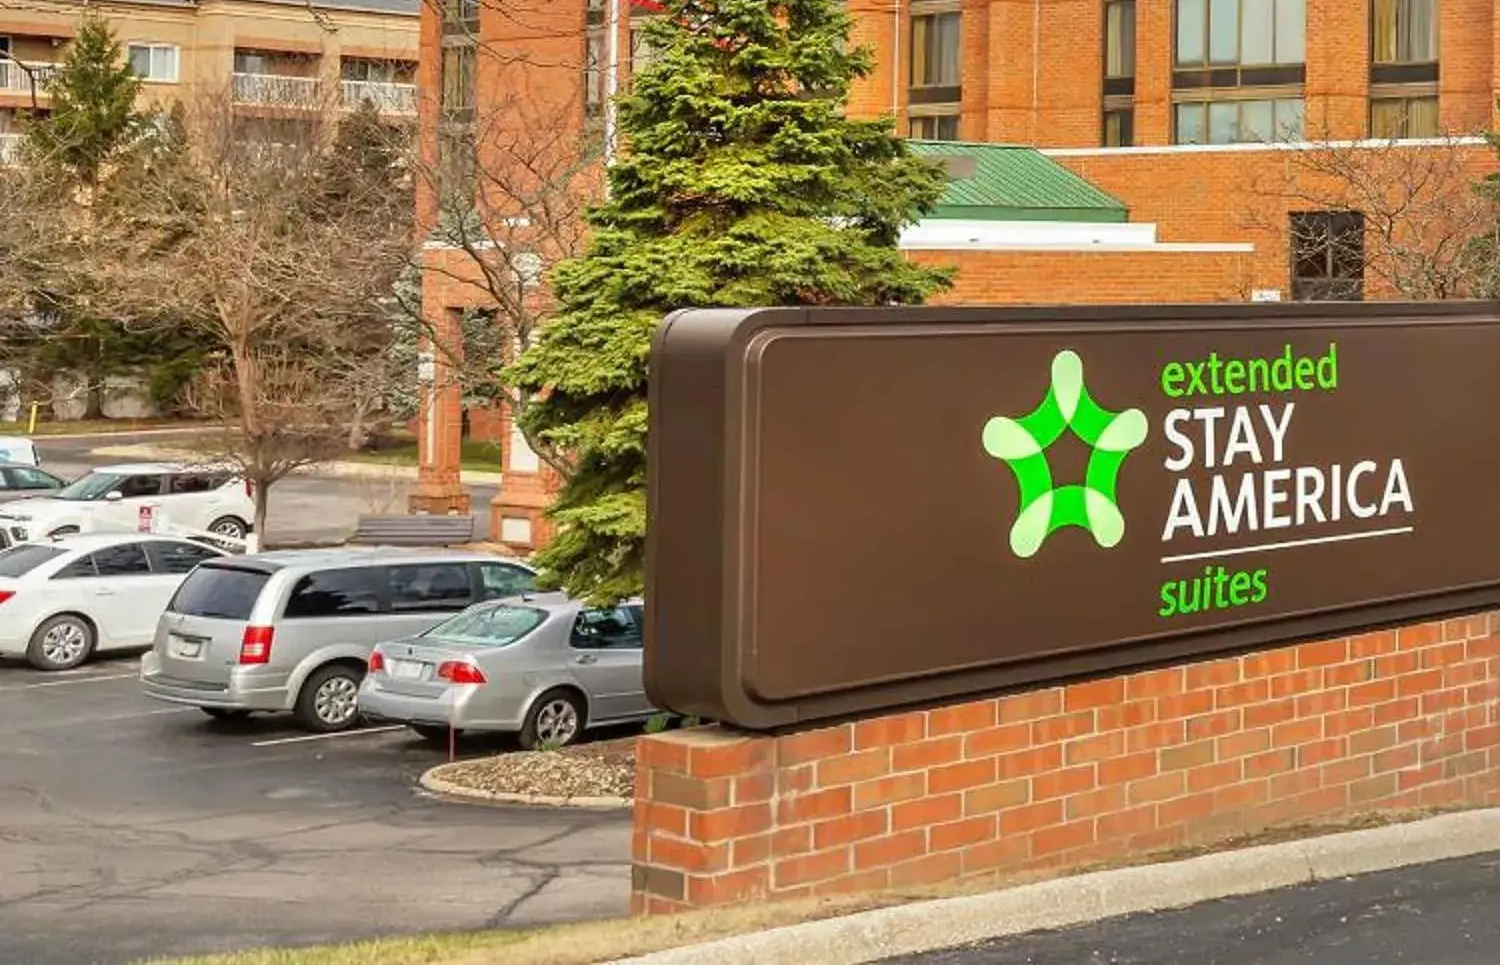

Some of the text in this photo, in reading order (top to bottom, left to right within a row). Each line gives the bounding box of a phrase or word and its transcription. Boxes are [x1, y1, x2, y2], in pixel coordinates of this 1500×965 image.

[1161, 343, 1337, 396] extended
[1163, 402, 1296, 471] STAY
[1161, 458, 1414, 541] AMERICA
[1159, 566, 1267, 617] suites
